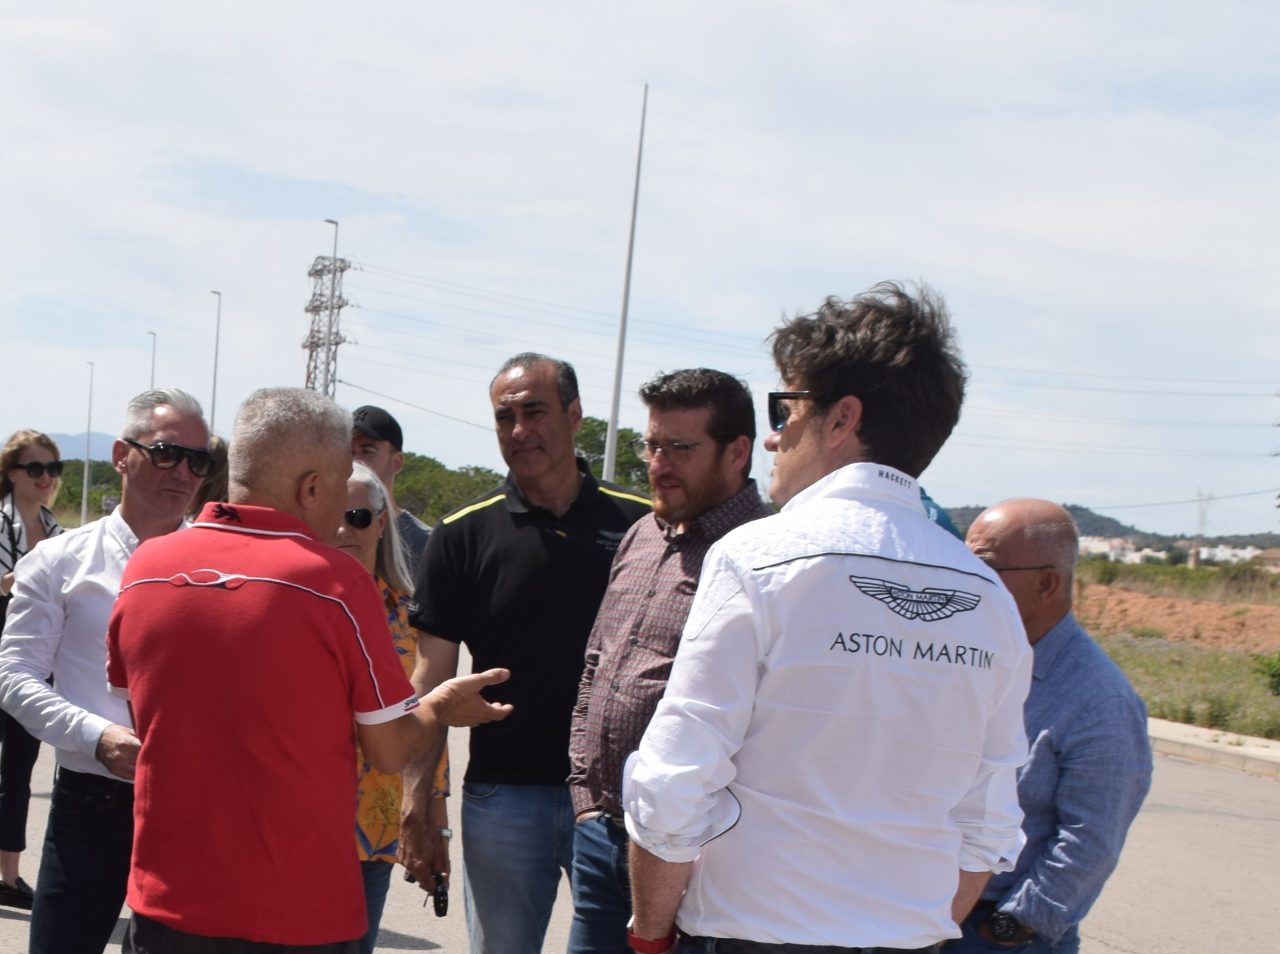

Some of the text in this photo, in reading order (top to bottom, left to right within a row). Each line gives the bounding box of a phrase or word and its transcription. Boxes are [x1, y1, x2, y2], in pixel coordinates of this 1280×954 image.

[878, 470, 912, 489] HACKETT
[830, 631, 995, 670] ASTON MARTIN
